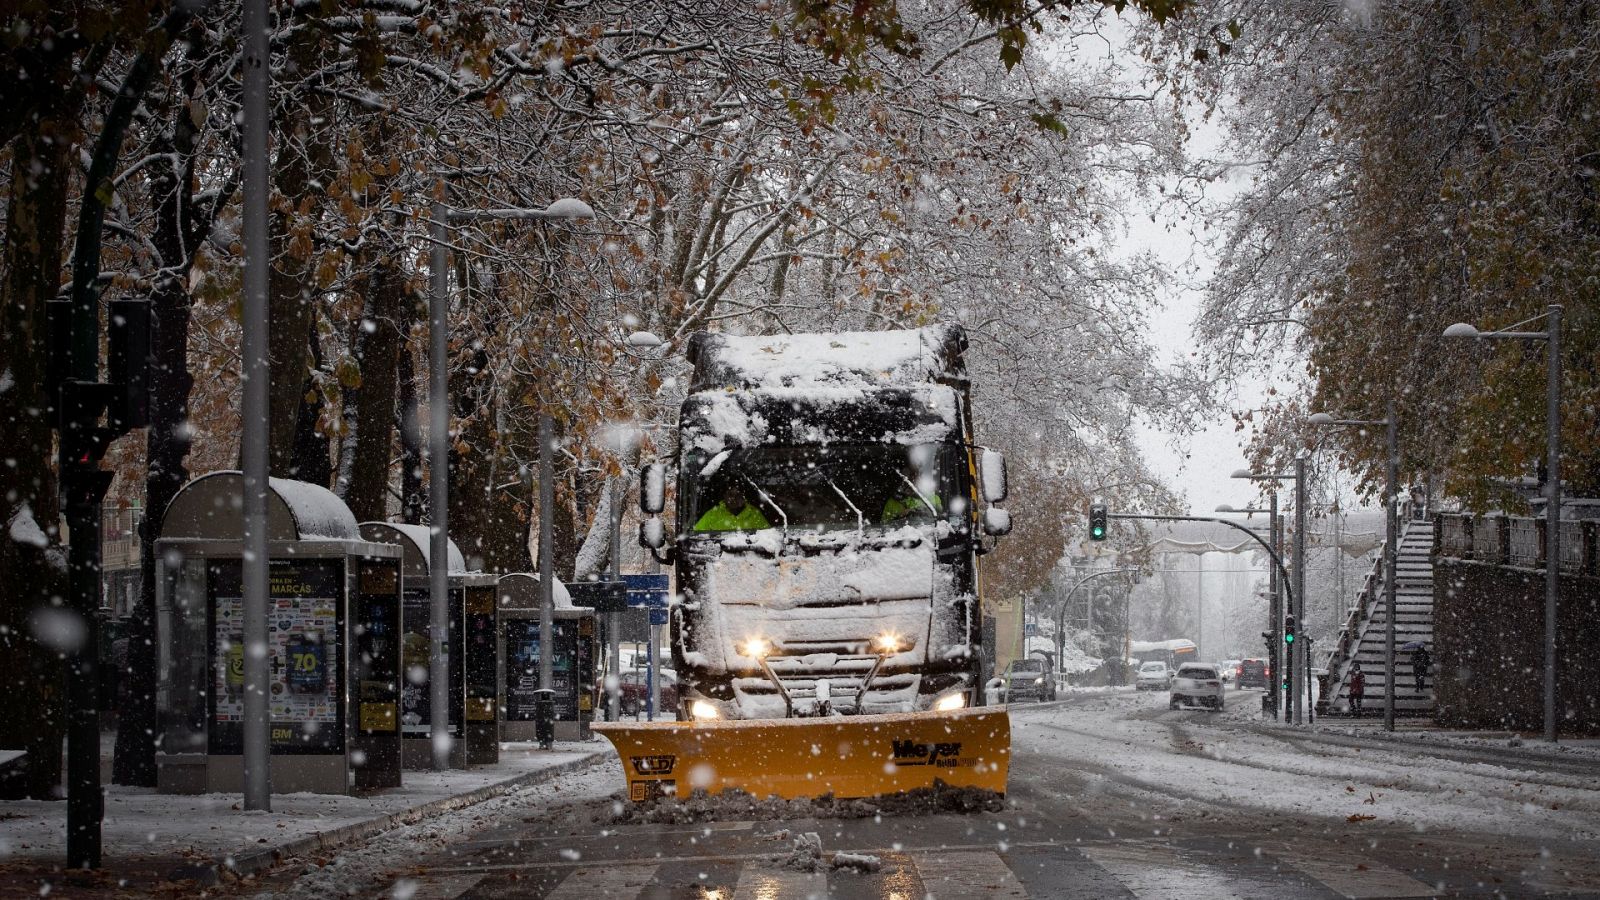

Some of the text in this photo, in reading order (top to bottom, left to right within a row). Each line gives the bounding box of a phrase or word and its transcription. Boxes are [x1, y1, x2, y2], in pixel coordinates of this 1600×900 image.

[293, 653, 317, 672] 70
[271, 728, 293, 739] BM
[892, 739, 962, 765] Meyer
